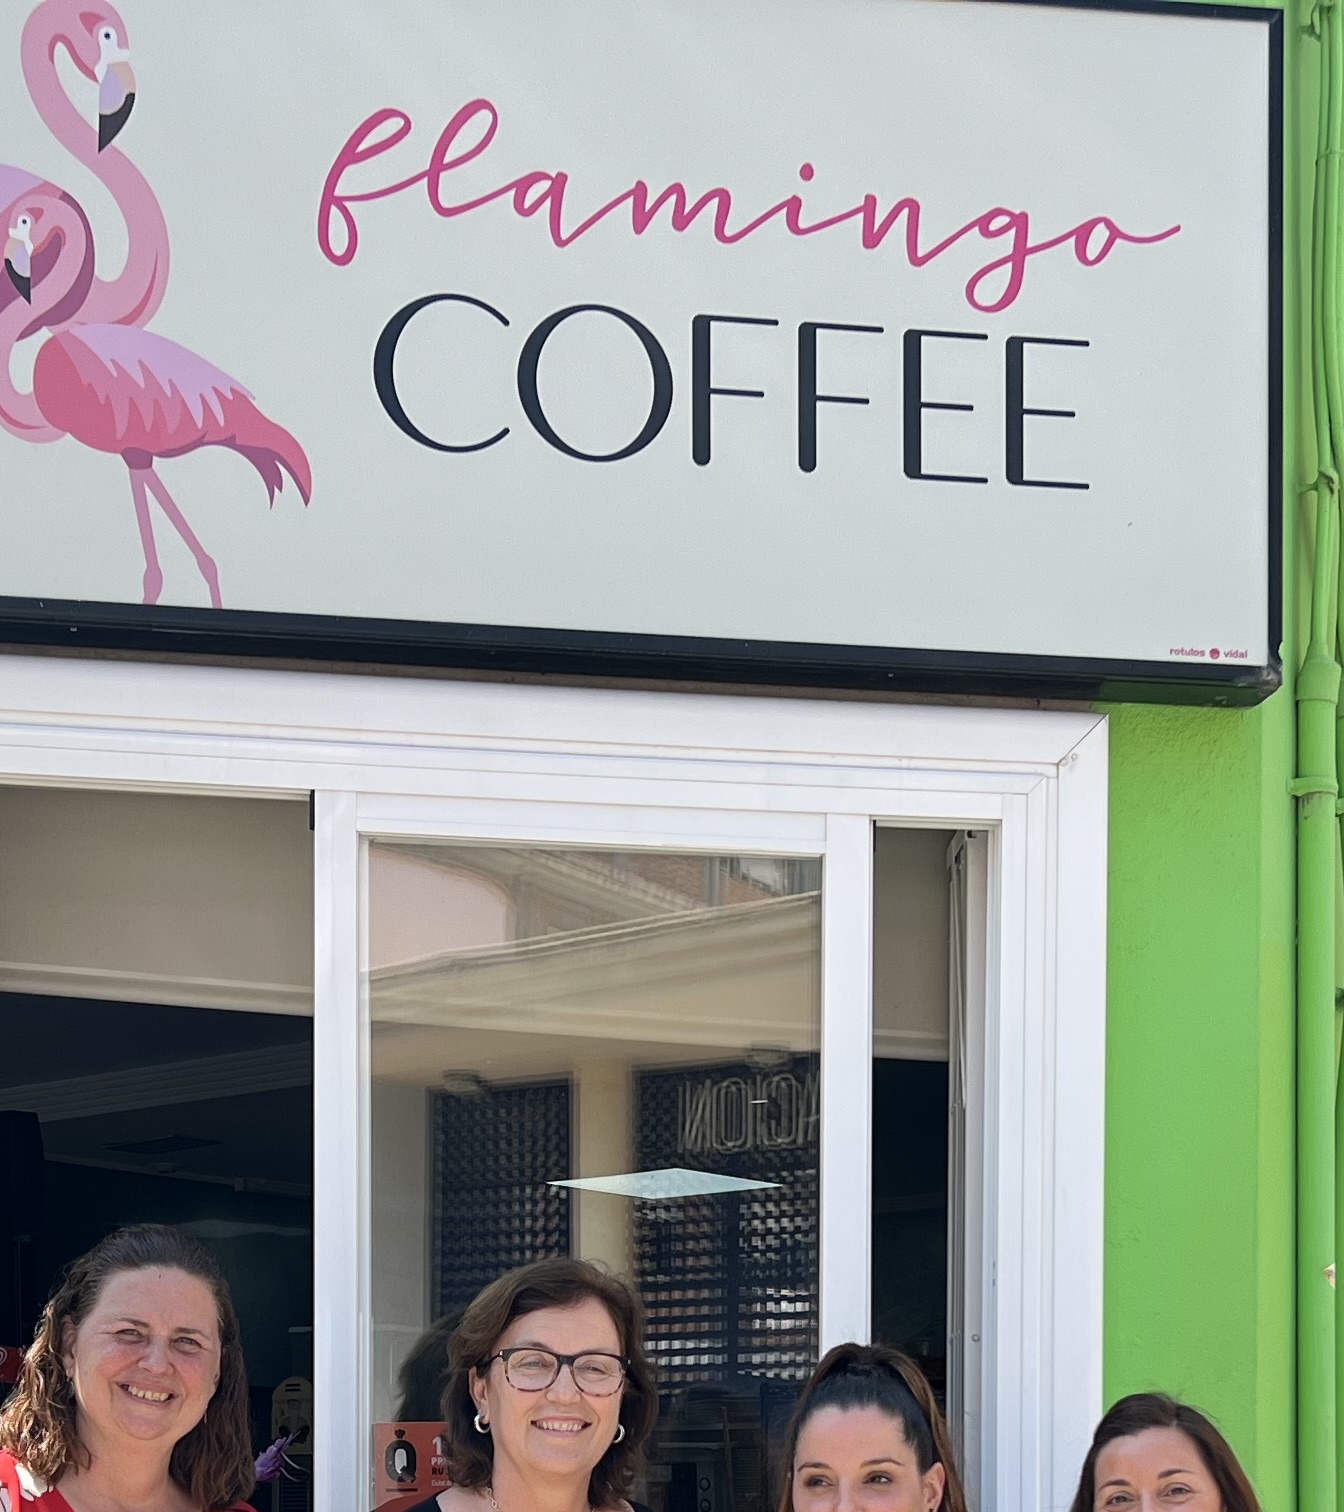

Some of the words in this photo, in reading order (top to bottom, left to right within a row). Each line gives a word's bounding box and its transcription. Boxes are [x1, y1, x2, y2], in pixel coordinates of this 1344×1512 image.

[316, 97, 1183, 313] flamingo
[372, 292, 1091, 491] COFFEE
[1223, 649, 1248, 659] vidal
